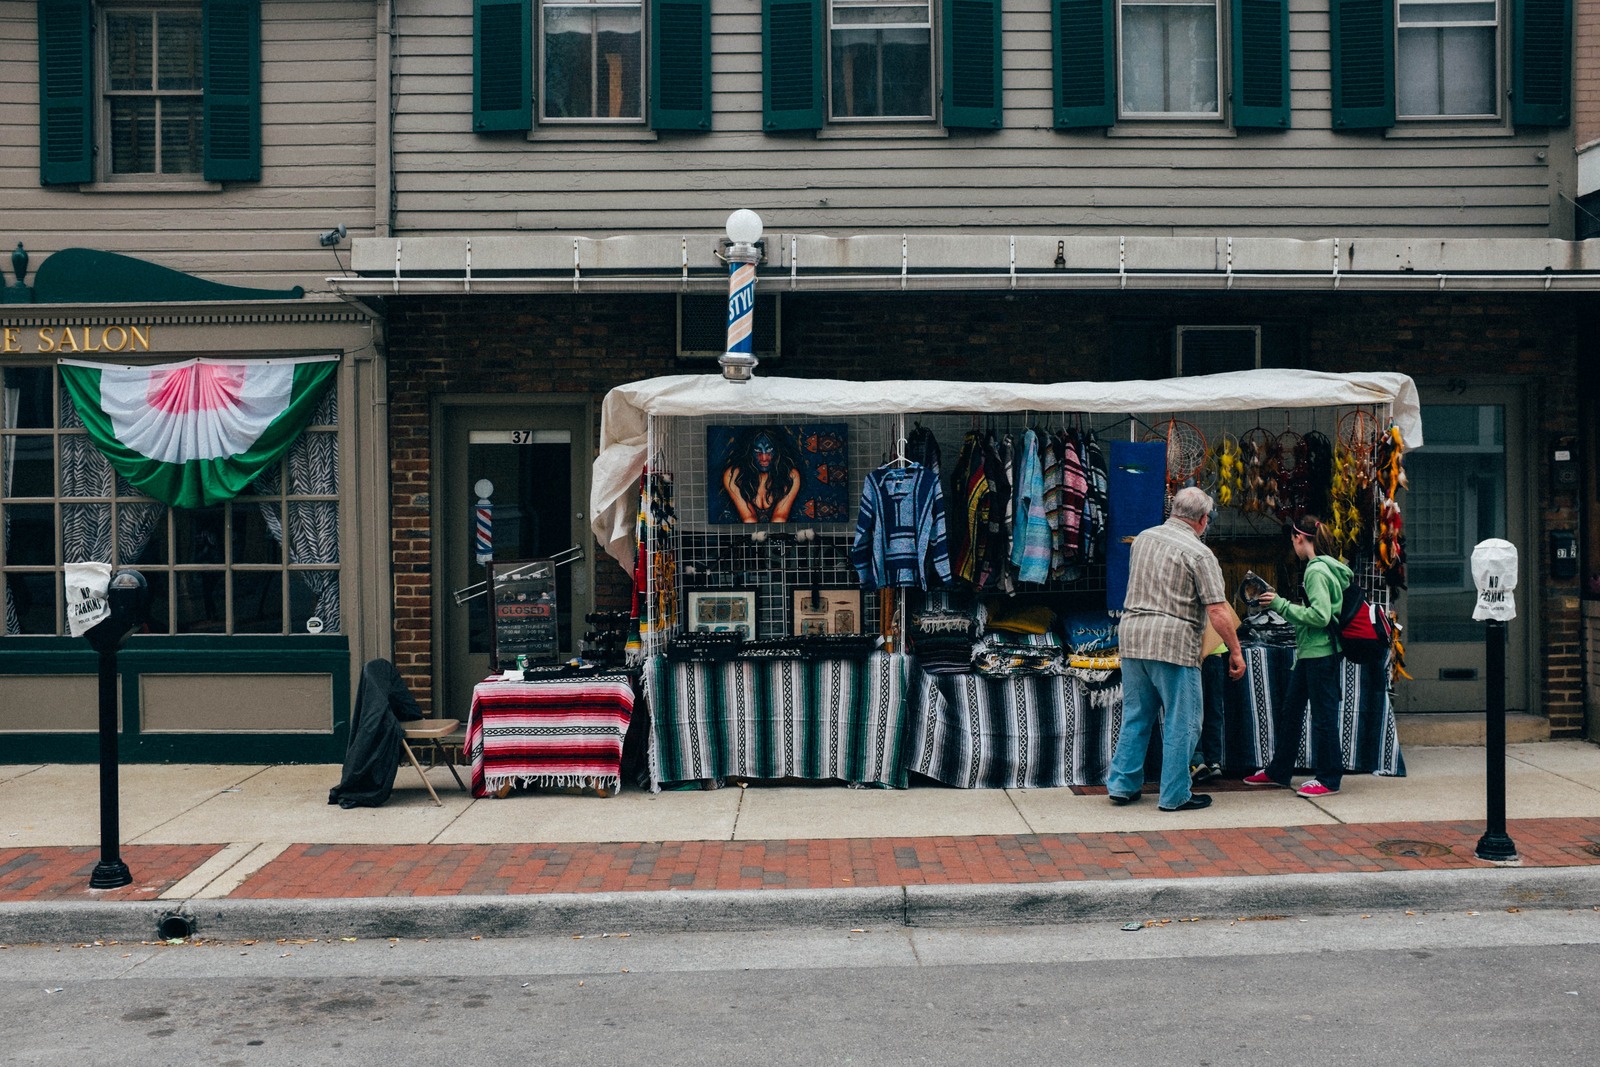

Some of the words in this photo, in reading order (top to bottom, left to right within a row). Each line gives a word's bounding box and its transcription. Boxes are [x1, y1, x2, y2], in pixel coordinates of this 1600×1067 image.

[729, 283, 754, 321] STYL
[38, 326, 151, 352] SALON
[513, 431, 530, 444] 37
[1489, 576, 1499, 588] NO
[80, 587, 90, 599] NO
[502, 607, 544, 615] CLOSED
